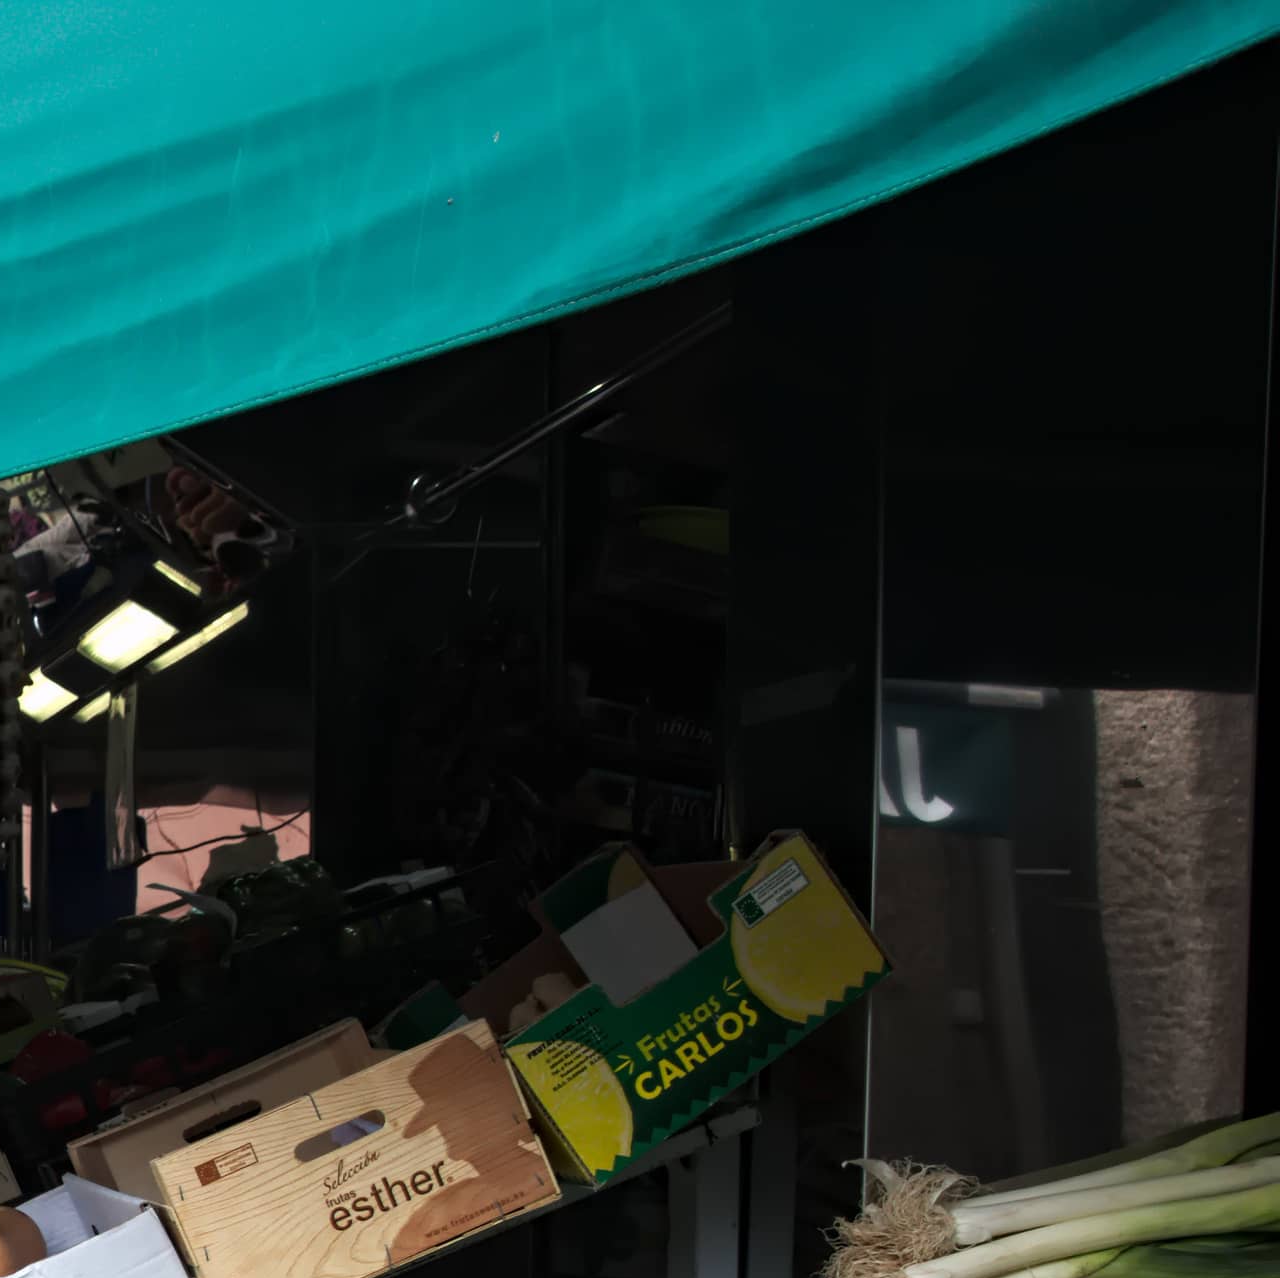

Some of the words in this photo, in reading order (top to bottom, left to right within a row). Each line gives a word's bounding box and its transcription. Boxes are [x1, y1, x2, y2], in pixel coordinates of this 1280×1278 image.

[634, 999, 759, 1100] CARLOS
[636, 994, 722, 1062] Frutas
[322, 1149, 381, 1197] Selección
[325, 1188, 357, 1208] frutas
[329, 1160, 446, 1232] esther
